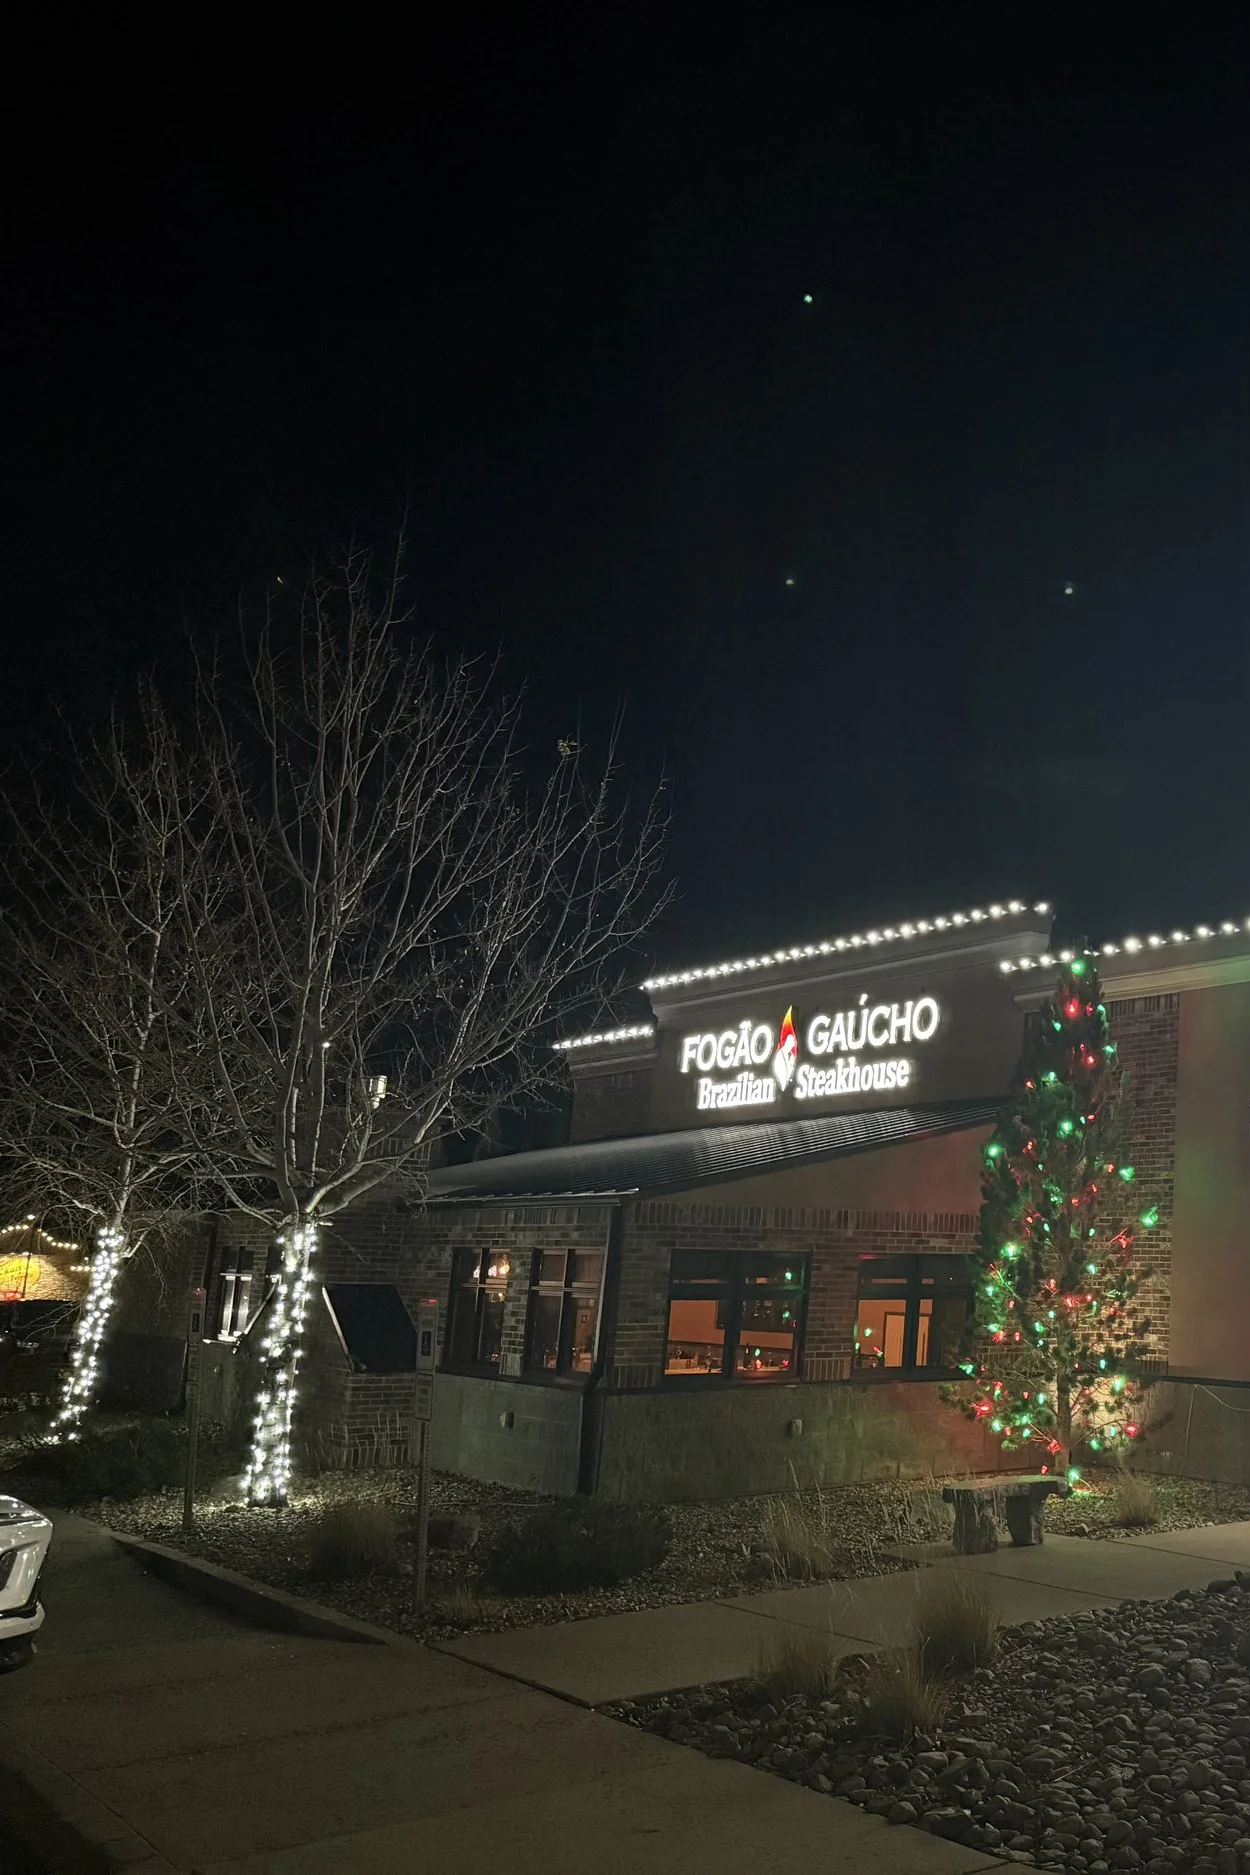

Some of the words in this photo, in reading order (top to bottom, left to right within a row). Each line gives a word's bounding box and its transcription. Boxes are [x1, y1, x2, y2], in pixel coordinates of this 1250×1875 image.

[680, 1020, 774, 1074] FOGÃO
[807, 993, 940, 1056] GAÚCHO
[696, 1071, 776, 1111] Brazilian
[794, 1056, 911, 1100] Steakhouse
